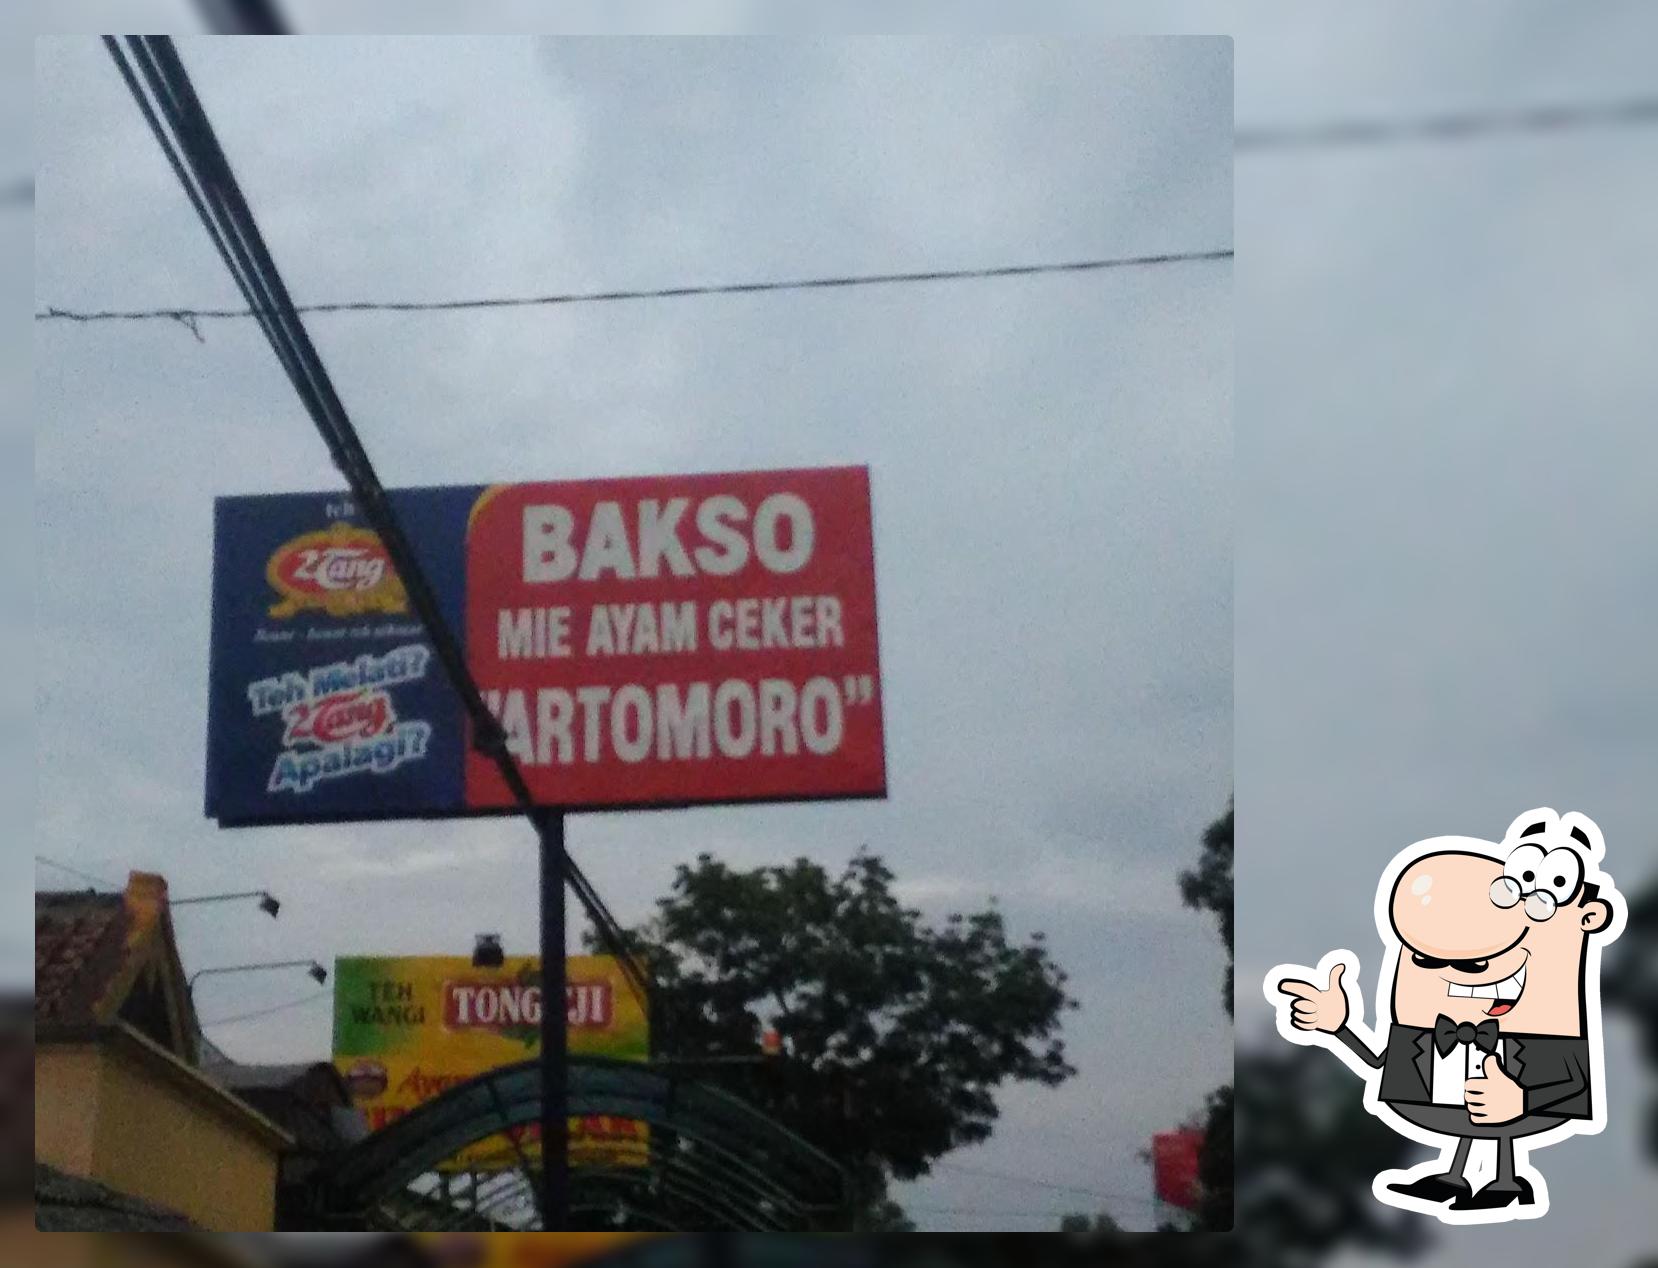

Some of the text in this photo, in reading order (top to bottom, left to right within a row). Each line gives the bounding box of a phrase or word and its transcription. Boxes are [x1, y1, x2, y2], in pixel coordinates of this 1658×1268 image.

[522, 492, 816, 583] BAKSO
[497, 595, 844, 661] MIE AYAM CEKER
[369, 980, 413, 1002] TEH
[351, 1004, 425, 1026] WANGI
